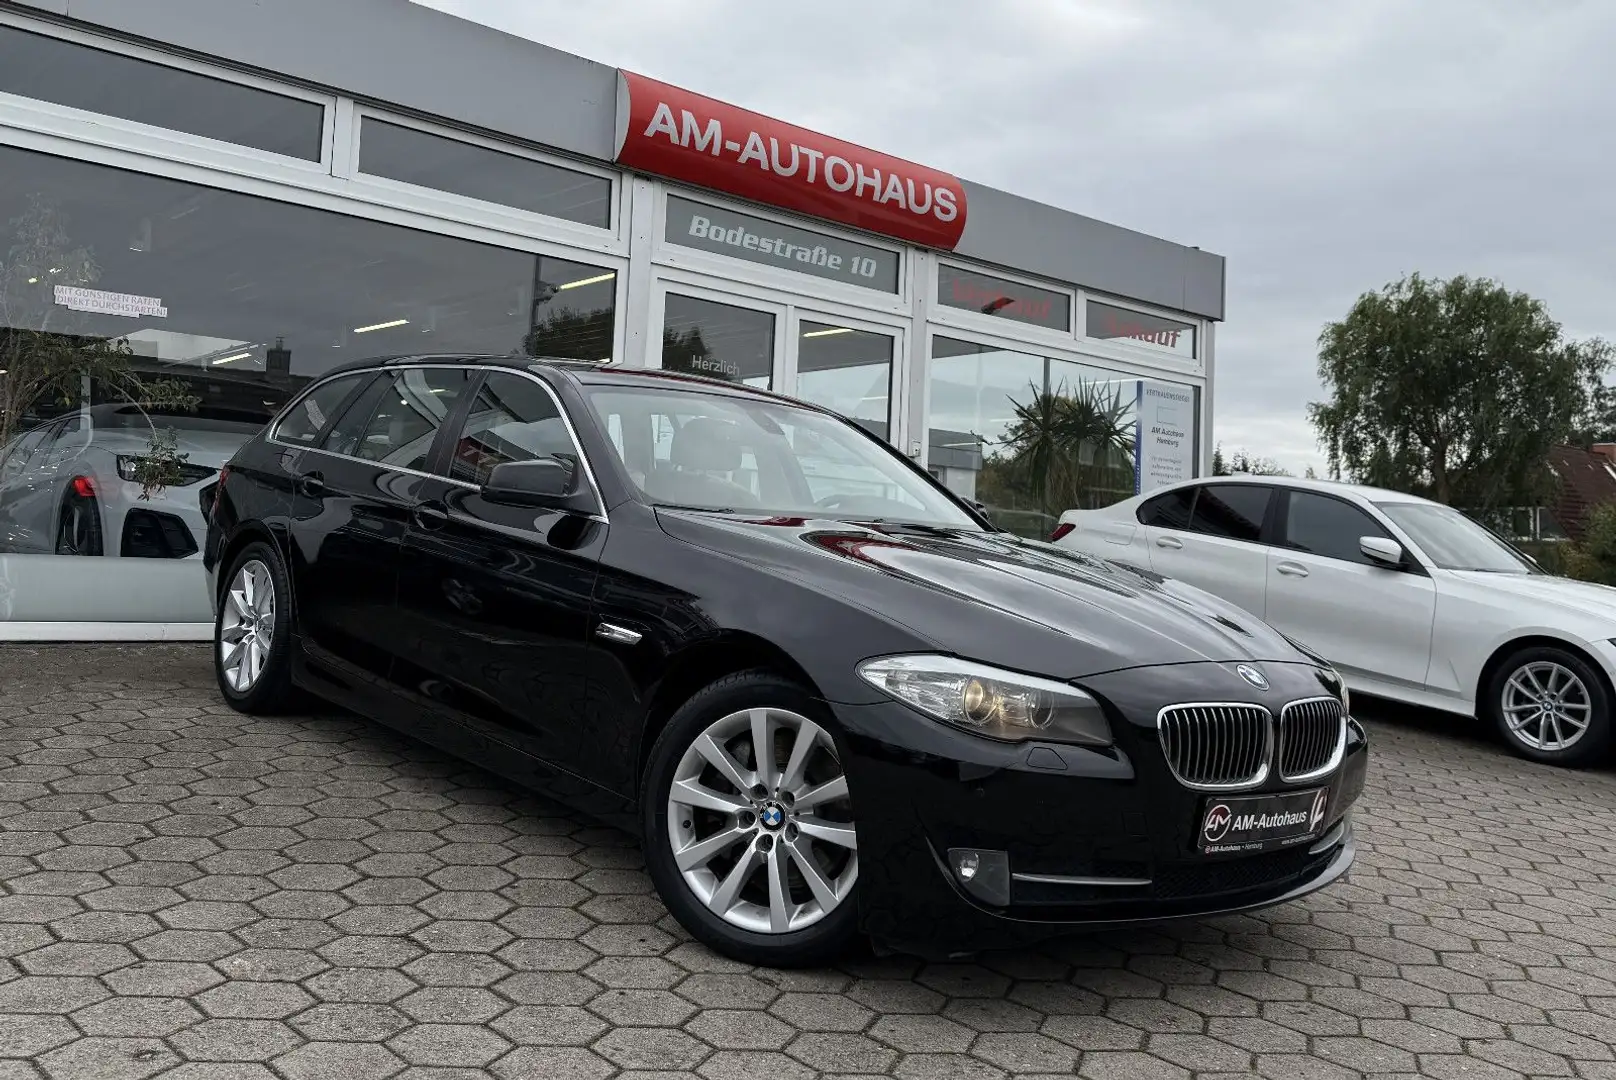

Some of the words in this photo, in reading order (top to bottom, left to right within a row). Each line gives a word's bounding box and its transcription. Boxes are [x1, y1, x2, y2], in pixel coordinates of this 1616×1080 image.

[644, 102, 958, 222] AM-AUTOHAUS
[688, 214, 842, 271] Bodestraße
[849, 254, 877, 279] 10
[55, 286, 73, 296] MIT
[691, 354, 740, 376] Herzlich
[1151, 426, 1161, 434] AM
[1232, 811, 1307, 831] AM-Autohaus
